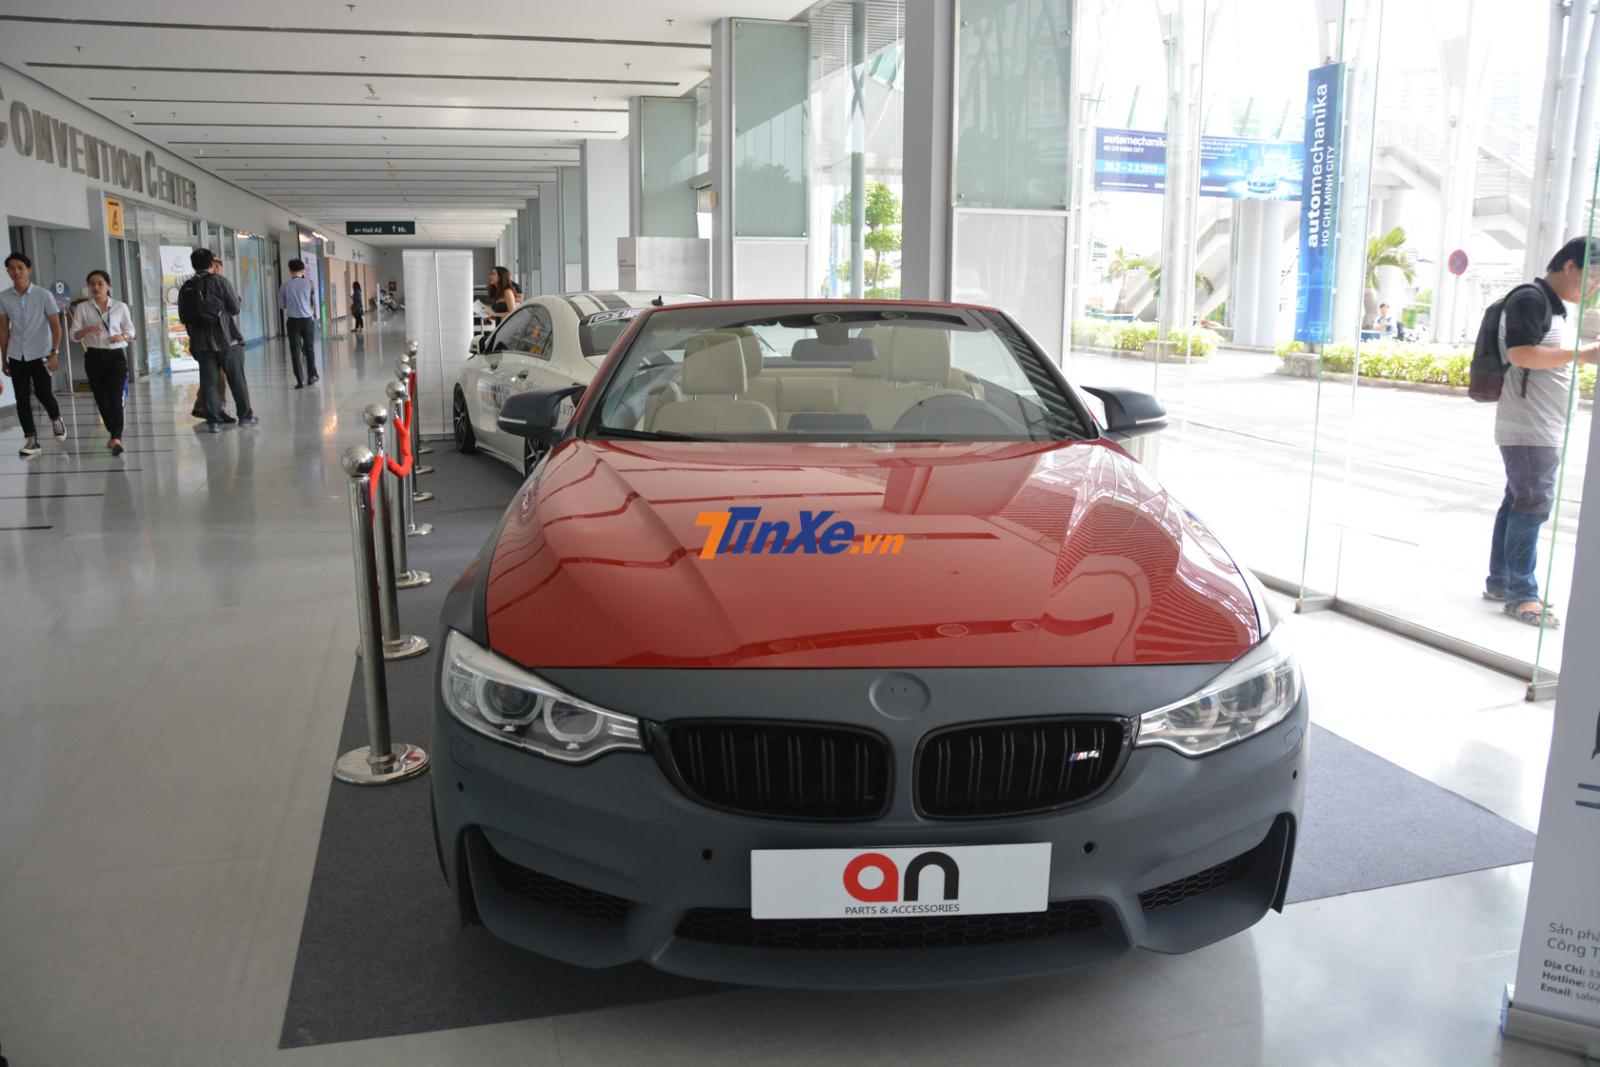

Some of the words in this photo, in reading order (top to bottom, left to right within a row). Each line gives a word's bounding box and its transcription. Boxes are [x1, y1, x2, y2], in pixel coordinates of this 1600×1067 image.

[1104, 135, 1166, 147] automechanik
[1307, 83, 1328, 248] automechanika
[1325, 146, 1335, 172] CITY
[1323, 174, 1334, 207] MINH
[1322, 208, 1331, 229] CHI
[1322, 230, 1330, 247] HO
[845, 905, 877, 915] PARTS
[879, 905, 889, 914] &
[891, 903, 960, 914] ACCESSORIES
[1547, 937, 1586, 958] Công
[1542, 971, 1586, 988] Hotline:
[1587, 980, 1600, 992] 02
